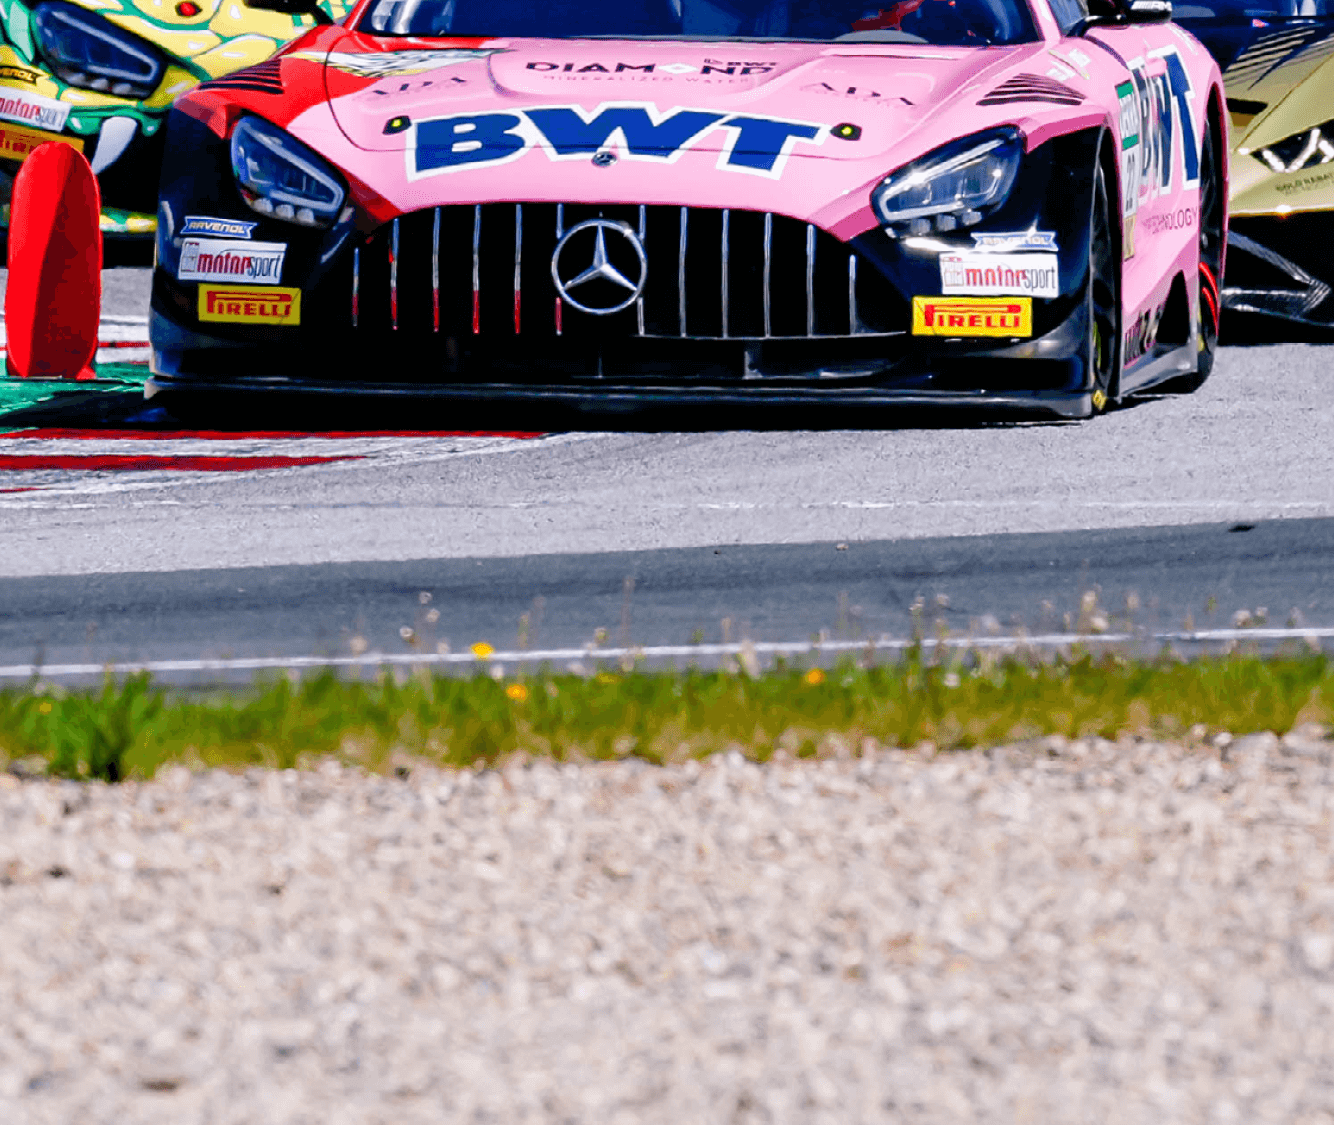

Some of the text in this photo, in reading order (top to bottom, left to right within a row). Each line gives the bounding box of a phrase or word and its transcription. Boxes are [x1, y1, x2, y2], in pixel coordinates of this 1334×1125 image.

[415, 105, 820, 174] BWT
[187, 221, 247, 234] RAVENOL
[197, 252, 281, 279] motorsport
[965, 265, 1056, 293] motorsport
[206, 290, 293, 318] PIRELLI
[924, 304, 1022, 328] PIRELLI
